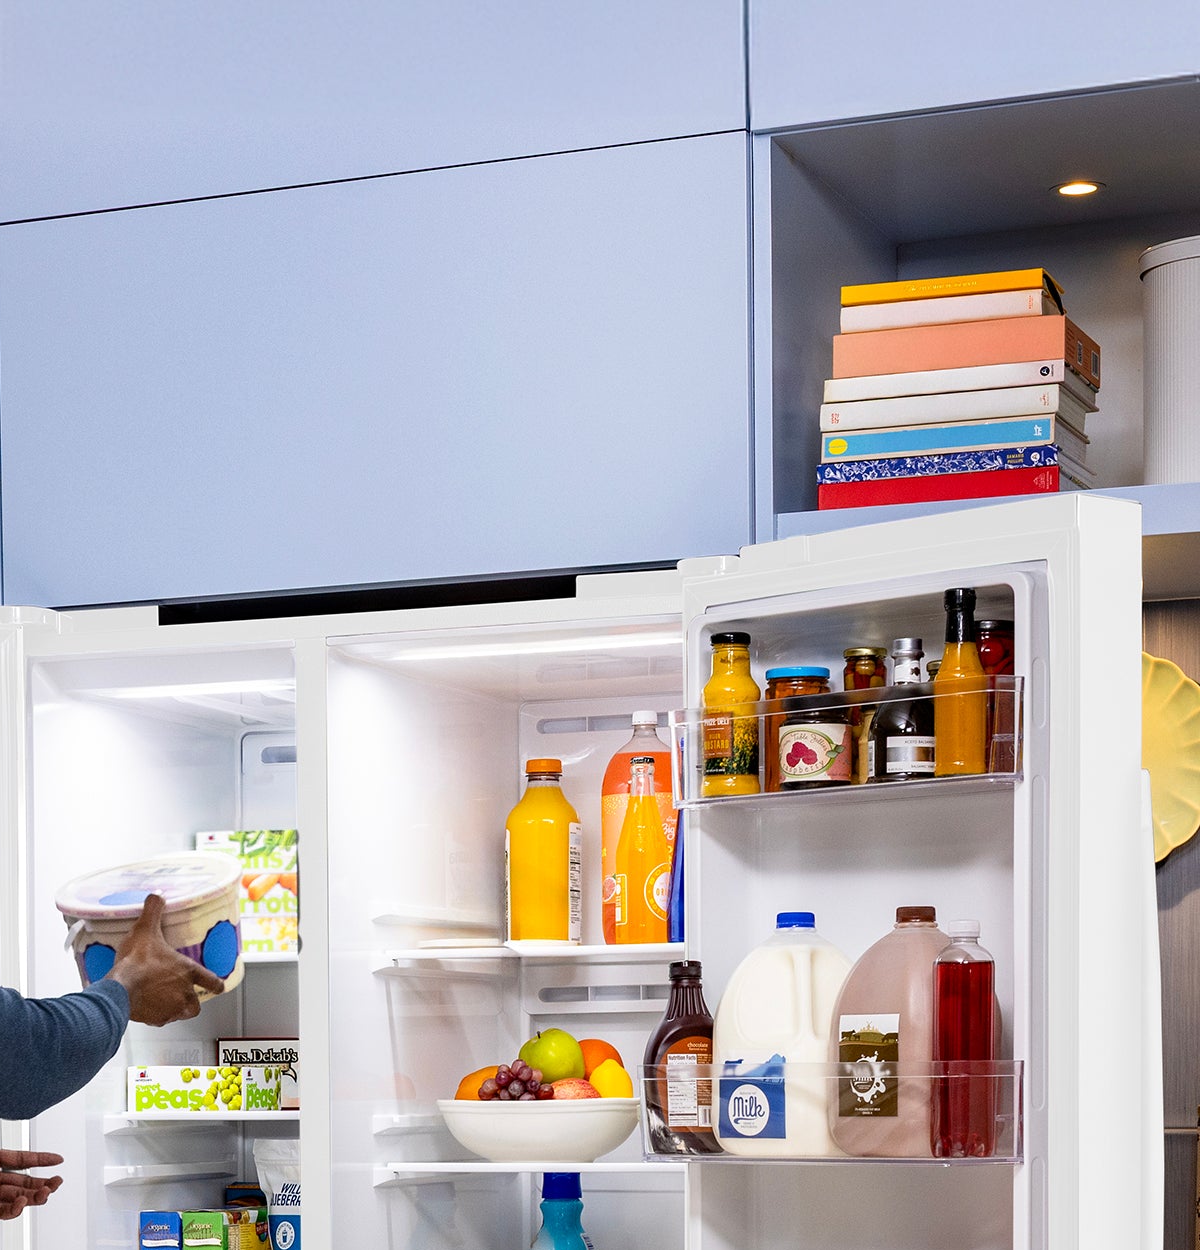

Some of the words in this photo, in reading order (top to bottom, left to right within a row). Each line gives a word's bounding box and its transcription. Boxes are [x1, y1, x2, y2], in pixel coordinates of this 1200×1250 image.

[223, 1048, 250, 1064] Mrs.
[251, 1047, 299, 1064] Dekab's
[135, 1089, 202, 1111] peas
[246, 1088, 274, 1111] peas
[733, 1095, 766, 1118] Milk
